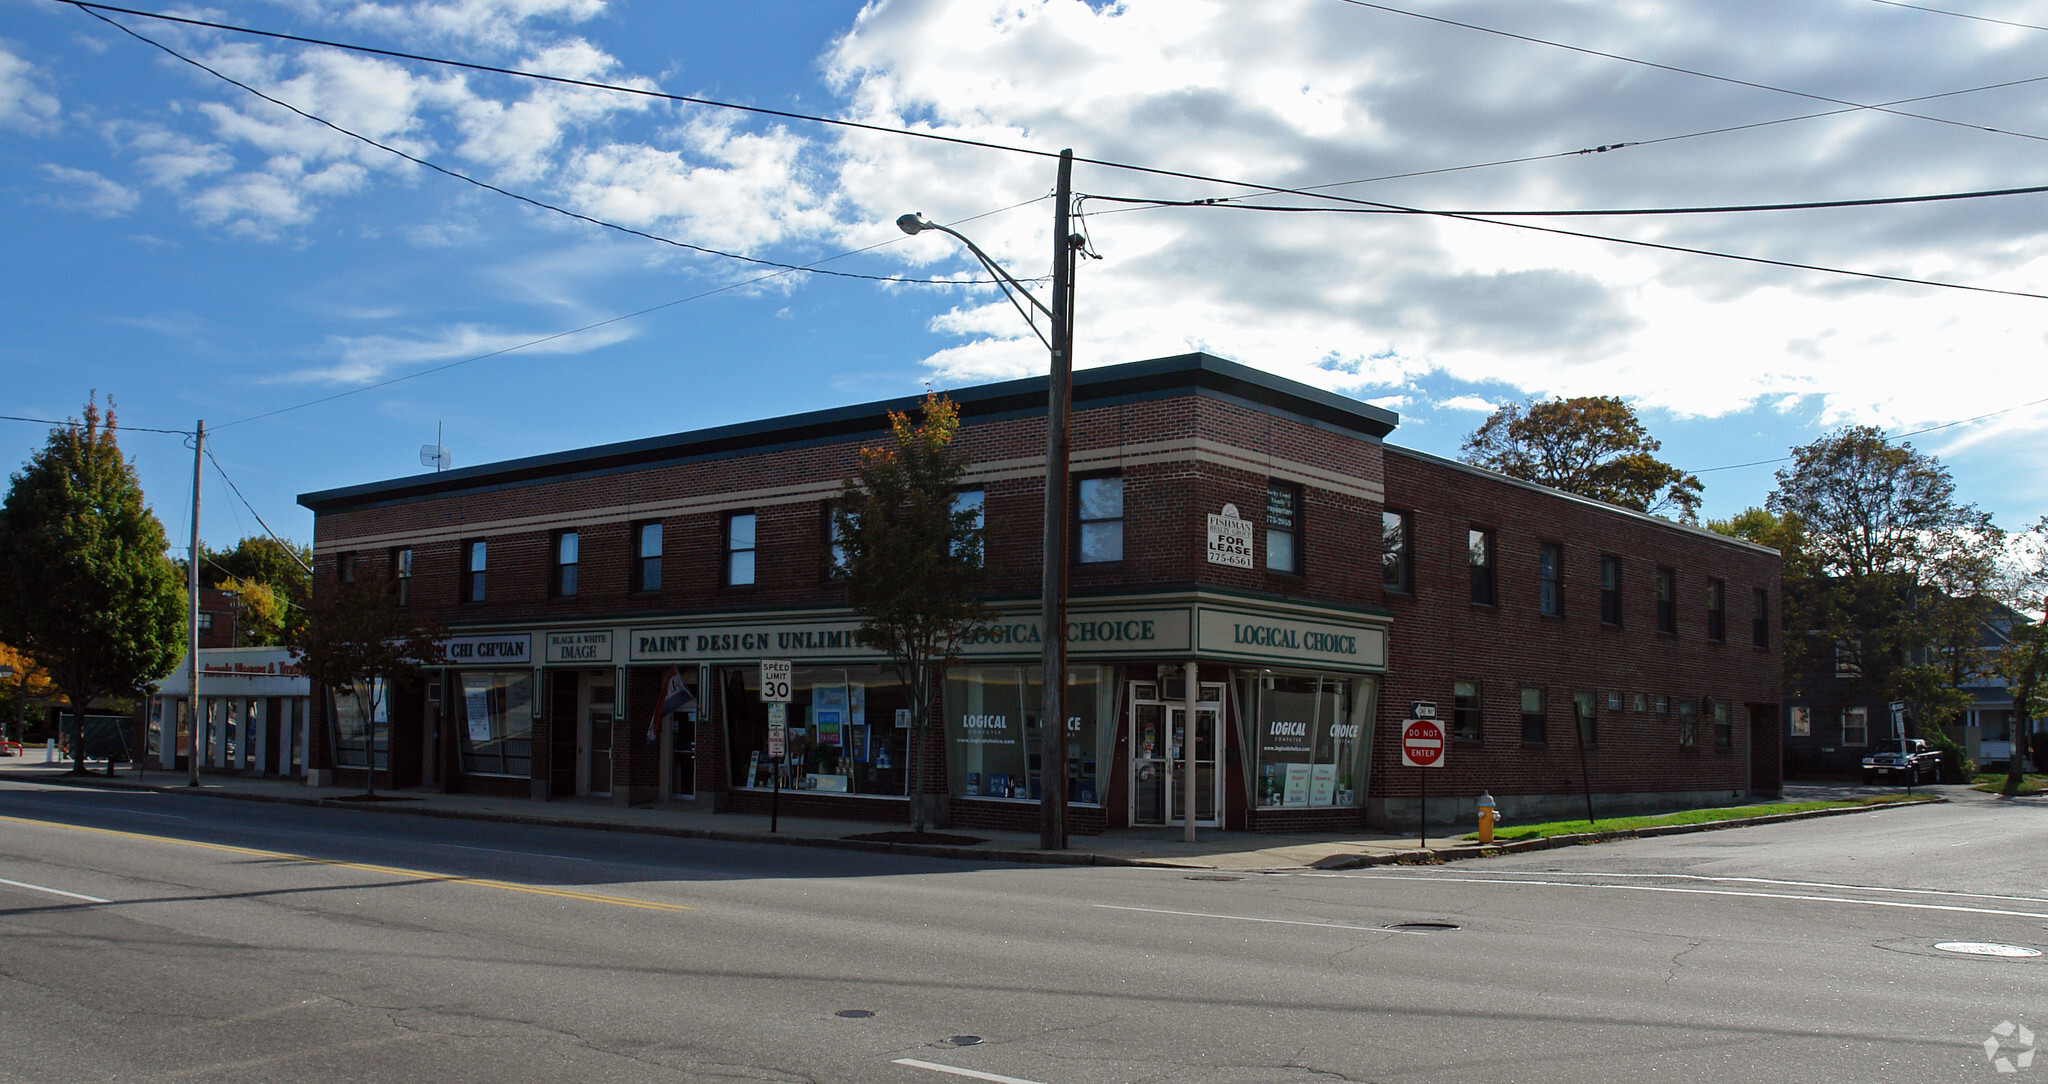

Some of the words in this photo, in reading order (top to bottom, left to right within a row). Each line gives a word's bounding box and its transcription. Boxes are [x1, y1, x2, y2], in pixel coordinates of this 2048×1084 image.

[1210, 516, 1251, 532] FISHMAN
[1210, 525, 1229, 534] REALTY
[1231, 529, 1251, 538] GROUP
[1218, 534, 1244, 546] FOR
[1209, 541, 1251, 556] LEASE
[1209, 552, 1251, 566] 775-6561
[552, 636, 574, 645] BLACK
[583, 634, 607, 644] WHITE
[962, 623, 1042, 645] LOGICA
[1066, 620, 1155, 642] CHOICE
[1234, 623, 1300, 649] LOGICAL
[1303, 631, 1357, 655] CHOICE
[451, 643, 473, 658] CHI
[477, 641, 524, 657] CH'UAN
[639, 636, 689, 653] PAINT
[696, 633, 769, 651] DESIGN
[560, 645, 597, 659] IMAGE
[763, 663, 789, 671] SPEED
[766, 672, 786, 680] LIMIT
[764, 681, 789, 697] 30
[962, 714, 1007, 729] LOGICAL
[1270, 721, 1306, 736] LOGICAL
[820, 733, 839, 742] PAINTS
[1329, 724, 1358, 738] CHOICE
[1409, 729, 1419, 737] DO
[1423, 729, 1438, 737] NOT
[1411, 749, 1435, 758] ENTER
